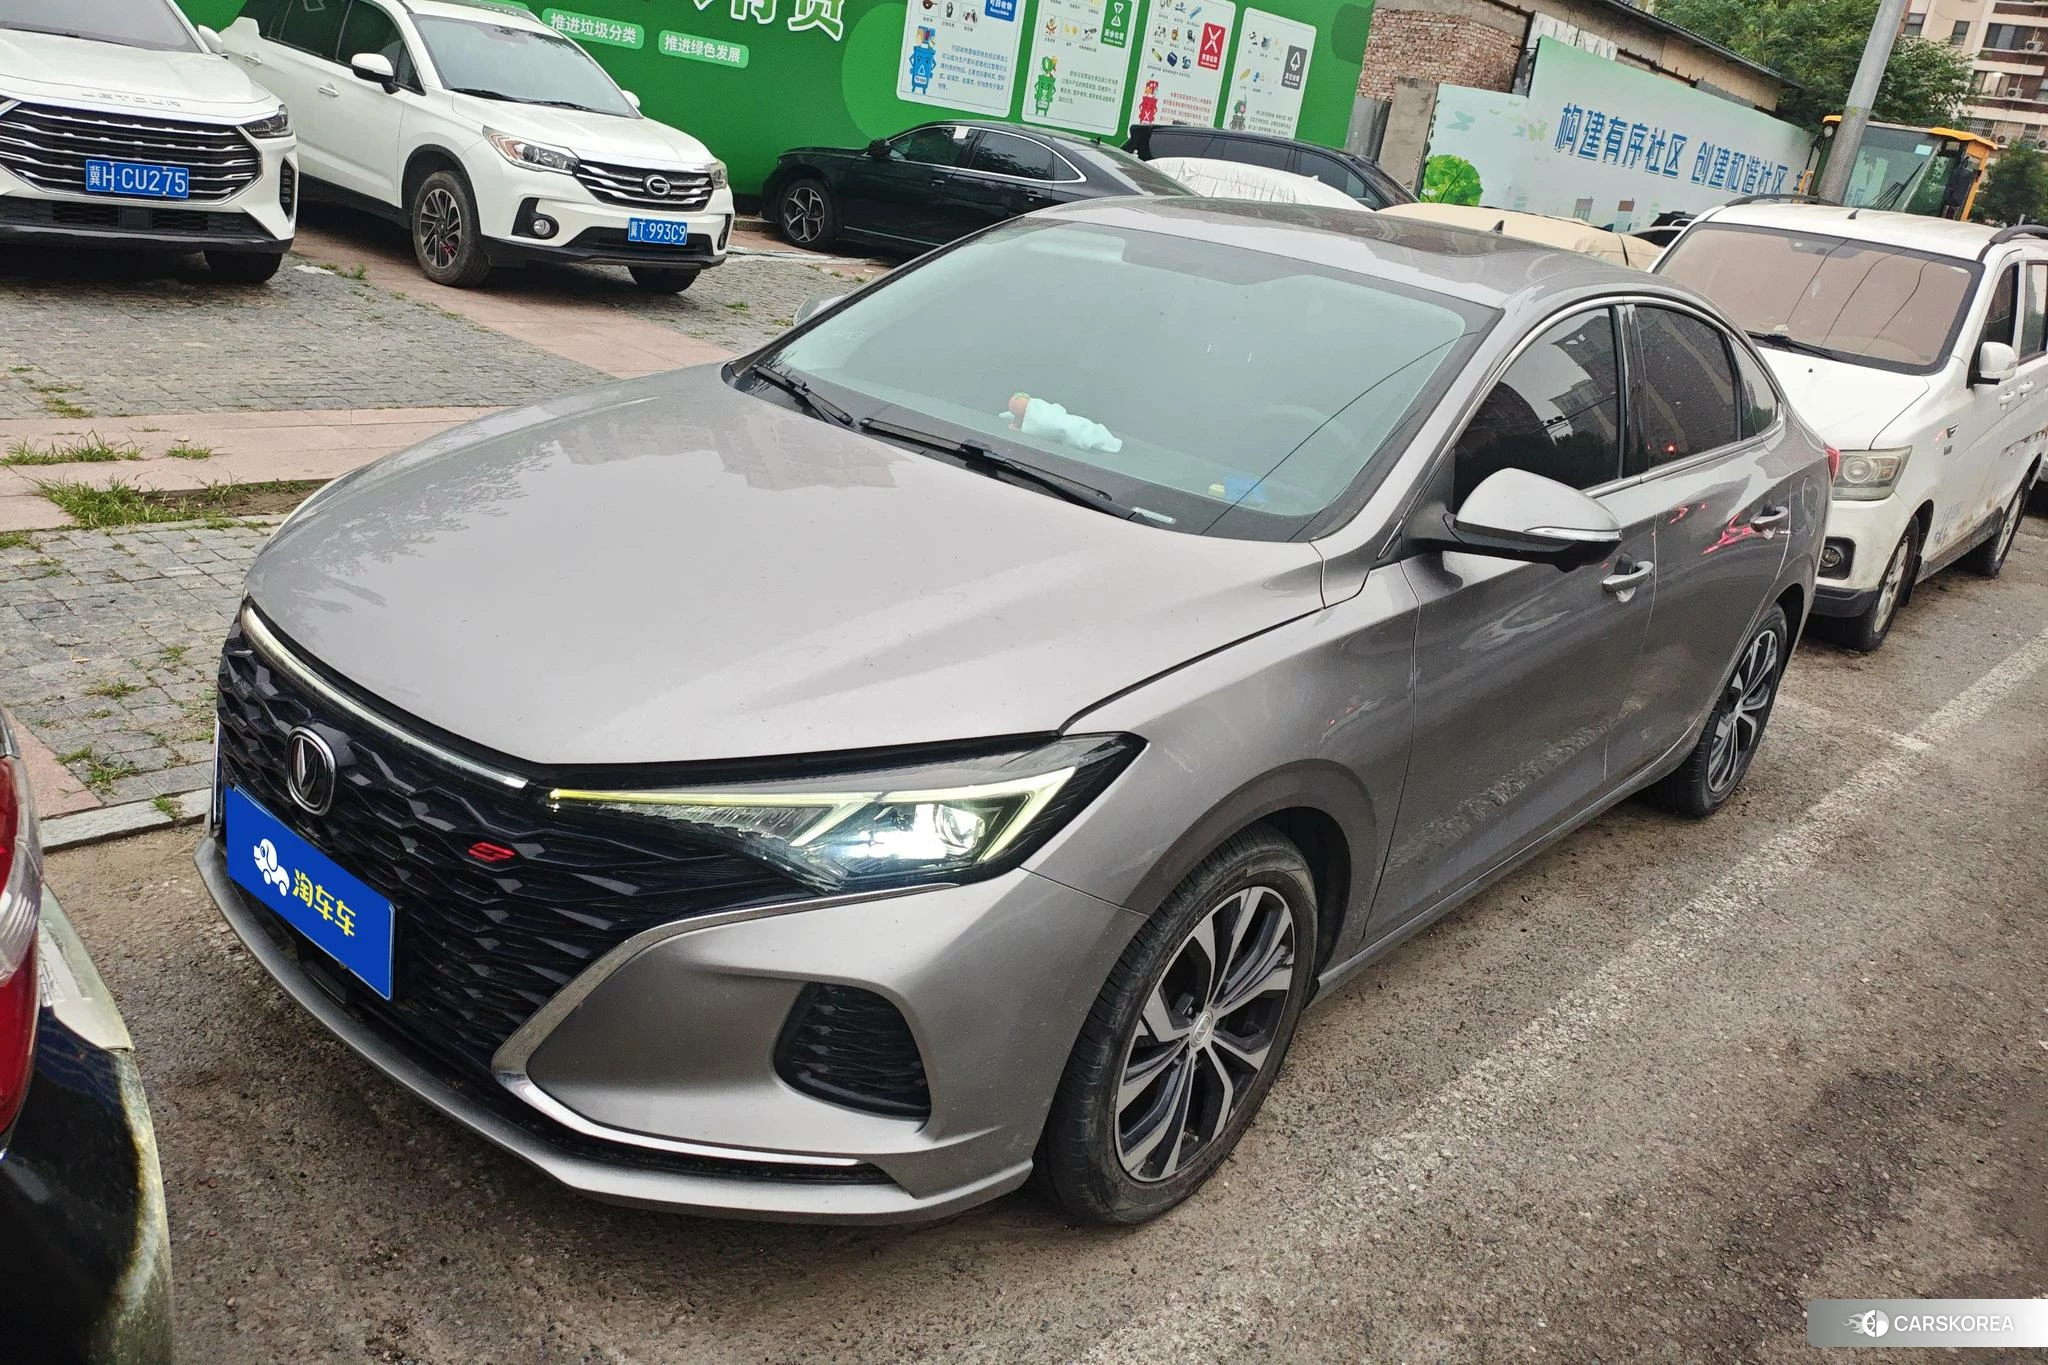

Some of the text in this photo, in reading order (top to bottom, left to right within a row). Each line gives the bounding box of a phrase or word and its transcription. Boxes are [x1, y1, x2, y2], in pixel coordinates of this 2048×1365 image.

[550, 13, 637, 45] 推进垃圾分类
[664, 35, 741, 63] 推进绿色发展
[1554, 103, 1688, 178] 构建有序社区
[1690, 141, 1789, 194] 创建和谐社区
